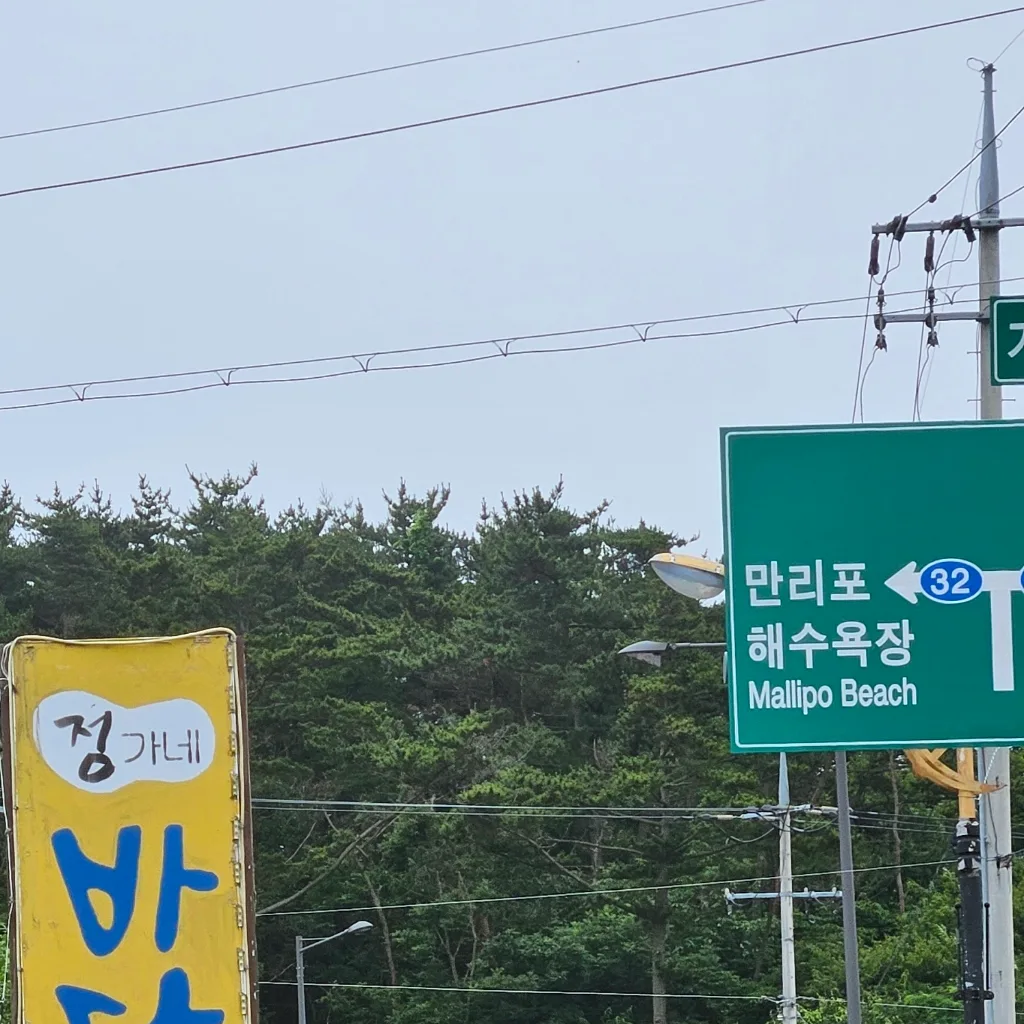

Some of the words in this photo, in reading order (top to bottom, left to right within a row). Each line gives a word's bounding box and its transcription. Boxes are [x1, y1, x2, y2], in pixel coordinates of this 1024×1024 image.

[746, 560, 871, 606] 만리포
[930, 567, 970, 596] 32
[747, 619, 914, 669] 해수욕장
[749, 680, 833, 714] Mallipo
[841, 677, 917, 707] Beach
